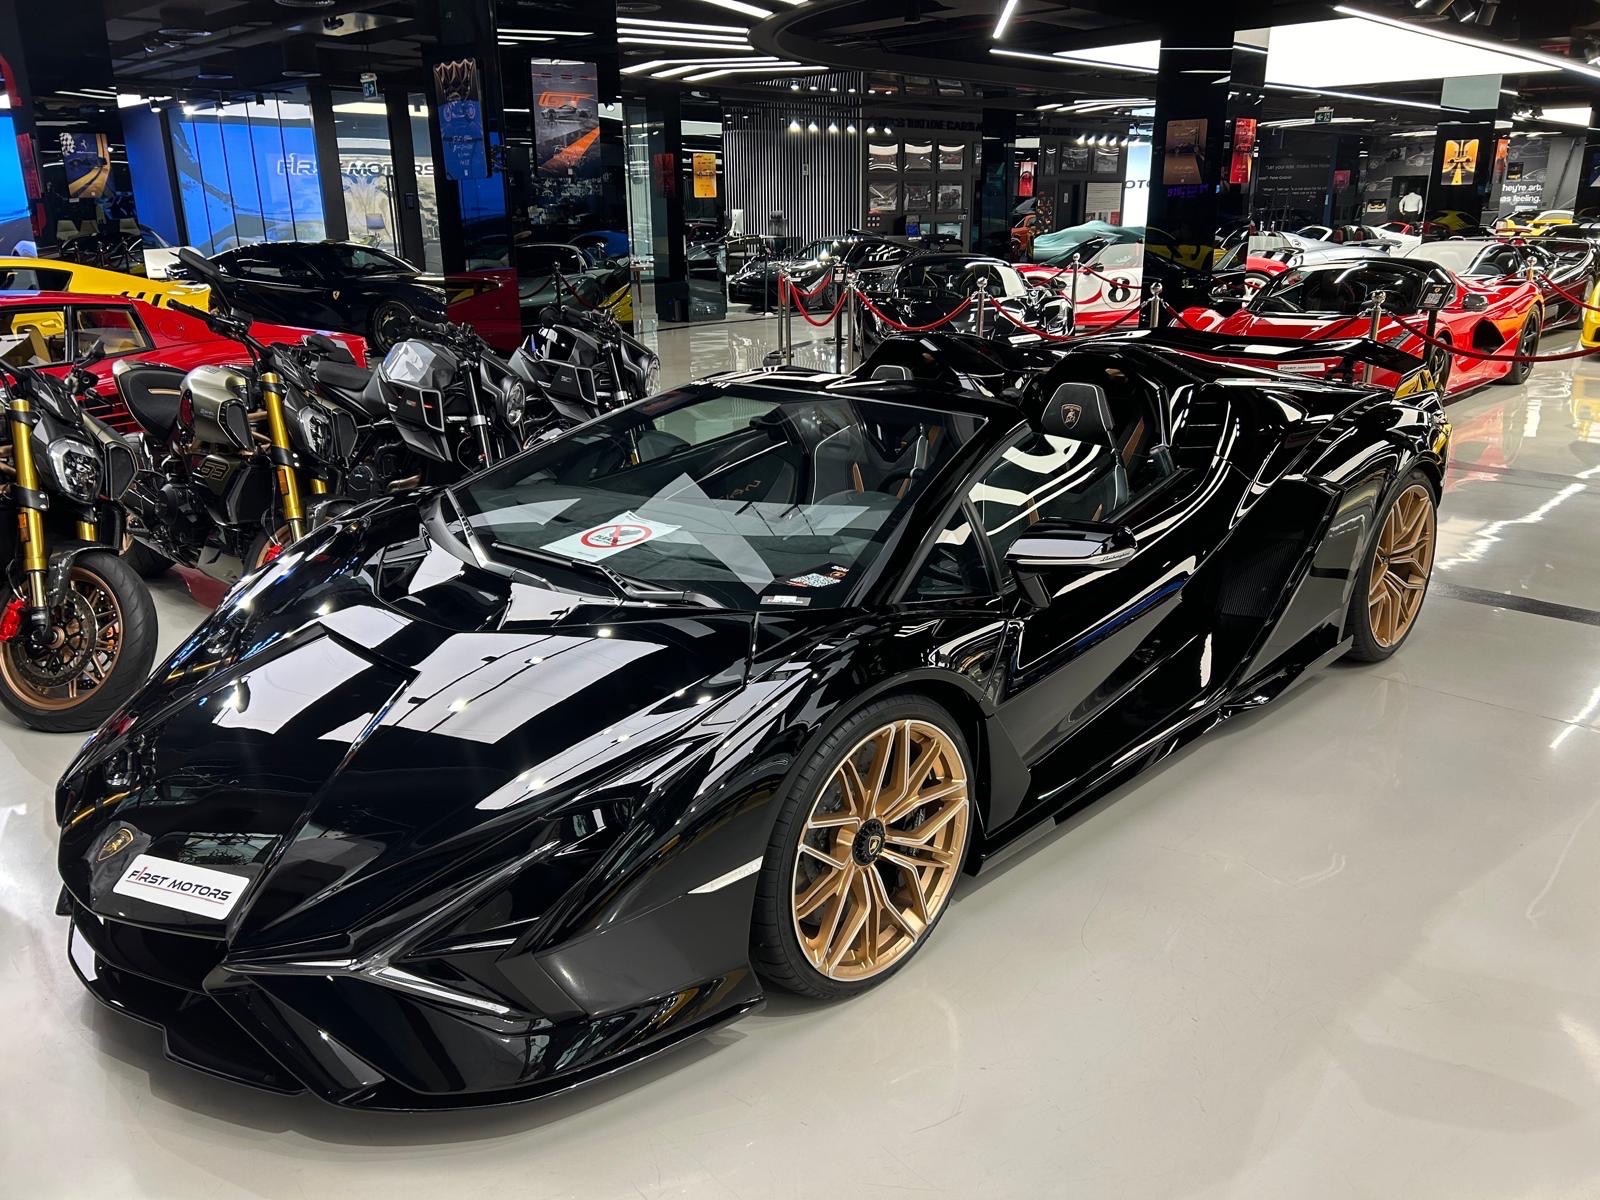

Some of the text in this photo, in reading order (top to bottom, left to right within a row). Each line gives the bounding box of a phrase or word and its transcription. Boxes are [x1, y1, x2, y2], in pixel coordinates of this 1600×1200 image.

[348, 162, 435, 177] MOTRS
[1107, 276, 1131, 302] 8
[167, 879, 233, 901] MOTORS
